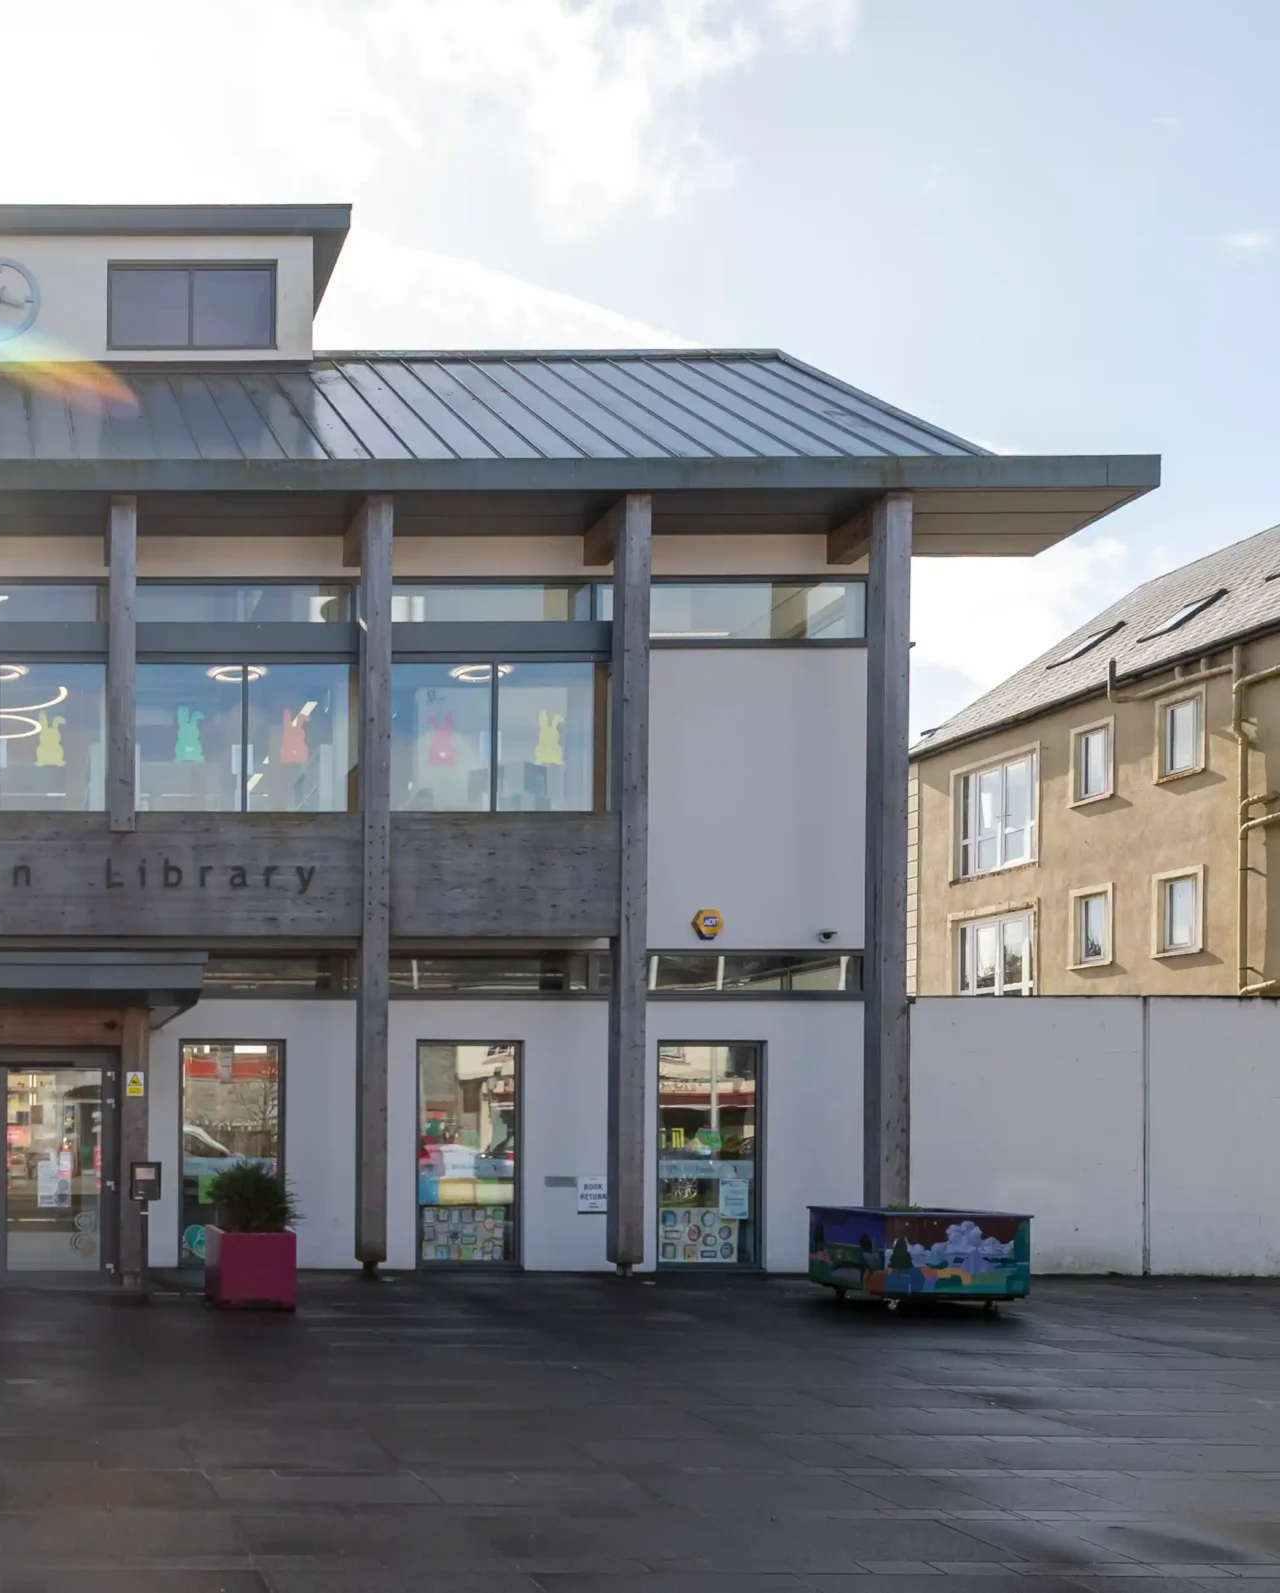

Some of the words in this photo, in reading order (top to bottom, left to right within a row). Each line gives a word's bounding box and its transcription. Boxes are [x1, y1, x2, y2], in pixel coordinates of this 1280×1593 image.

[105, 858, 316, 895] Library
[704, 918, 718, 926] ADT
[583, 1183, 604, 1191] BOOK
[580, 1193, 608, 1201] RETURN
